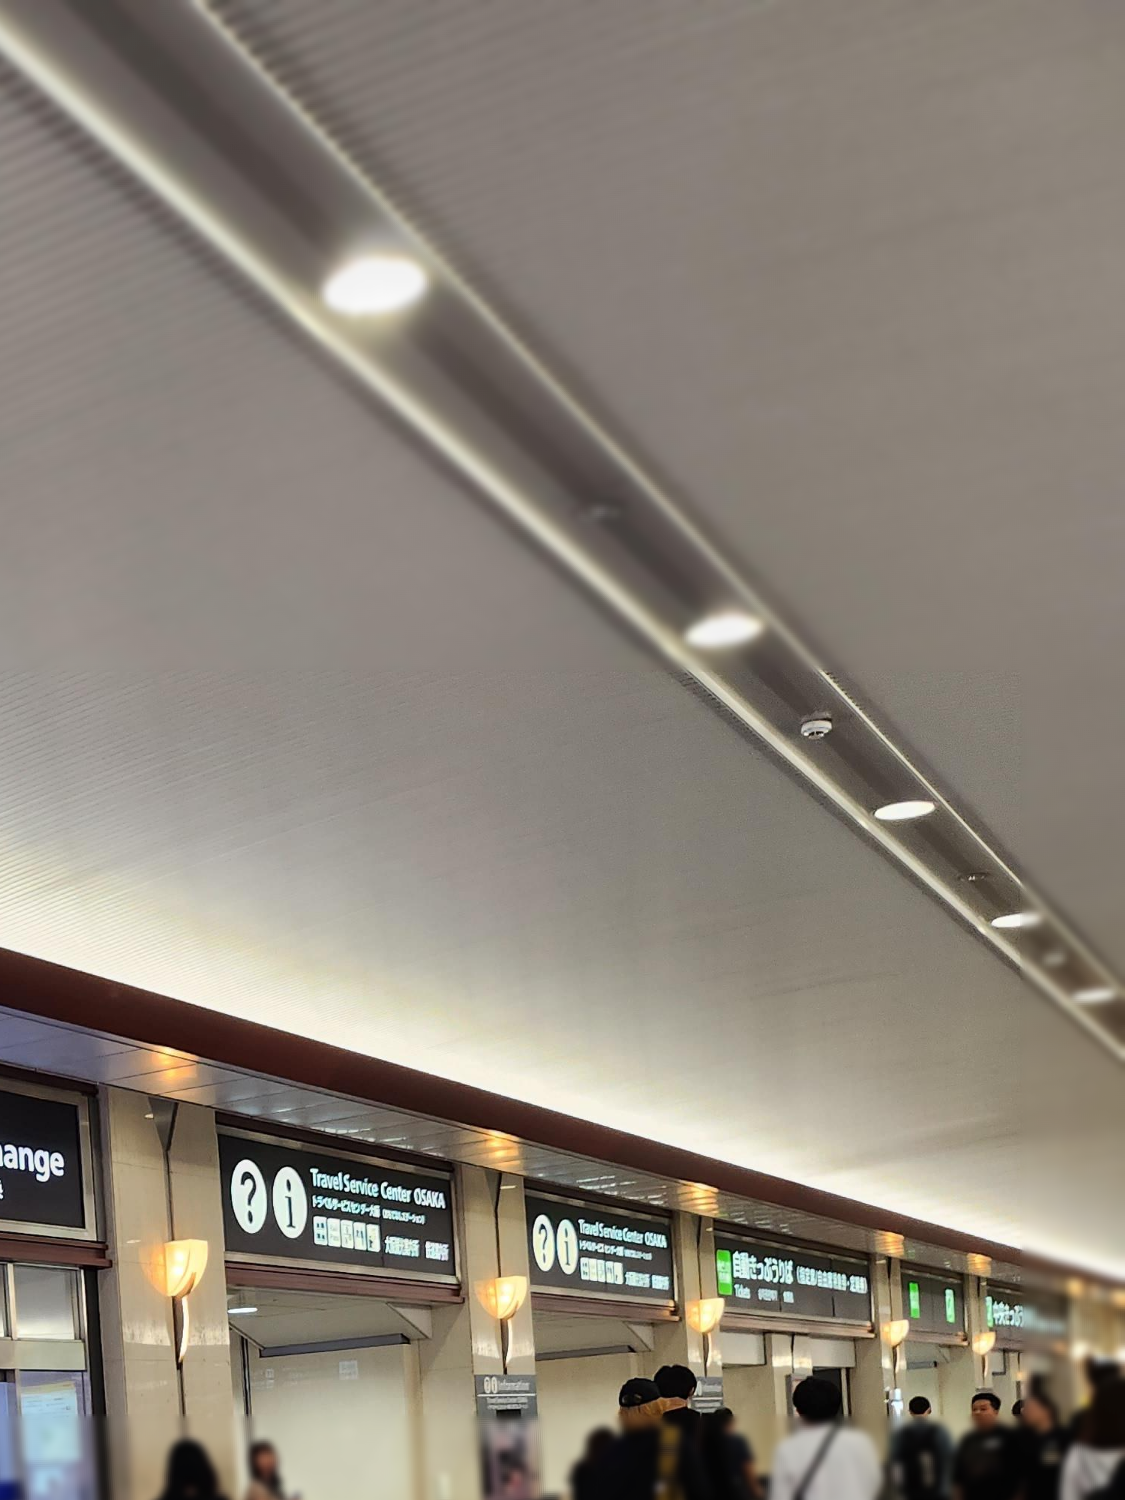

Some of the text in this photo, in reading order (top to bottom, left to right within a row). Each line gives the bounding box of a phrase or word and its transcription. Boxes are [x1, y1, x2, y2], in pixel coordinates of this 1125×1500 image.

[310, 1168, 446, 1209] Travel Service Center OSAKA
[578, 1219, 667, 1249] Travel Service Center OSAKA
[732, 1250, 794, 1285] 自動きっぷうりば
